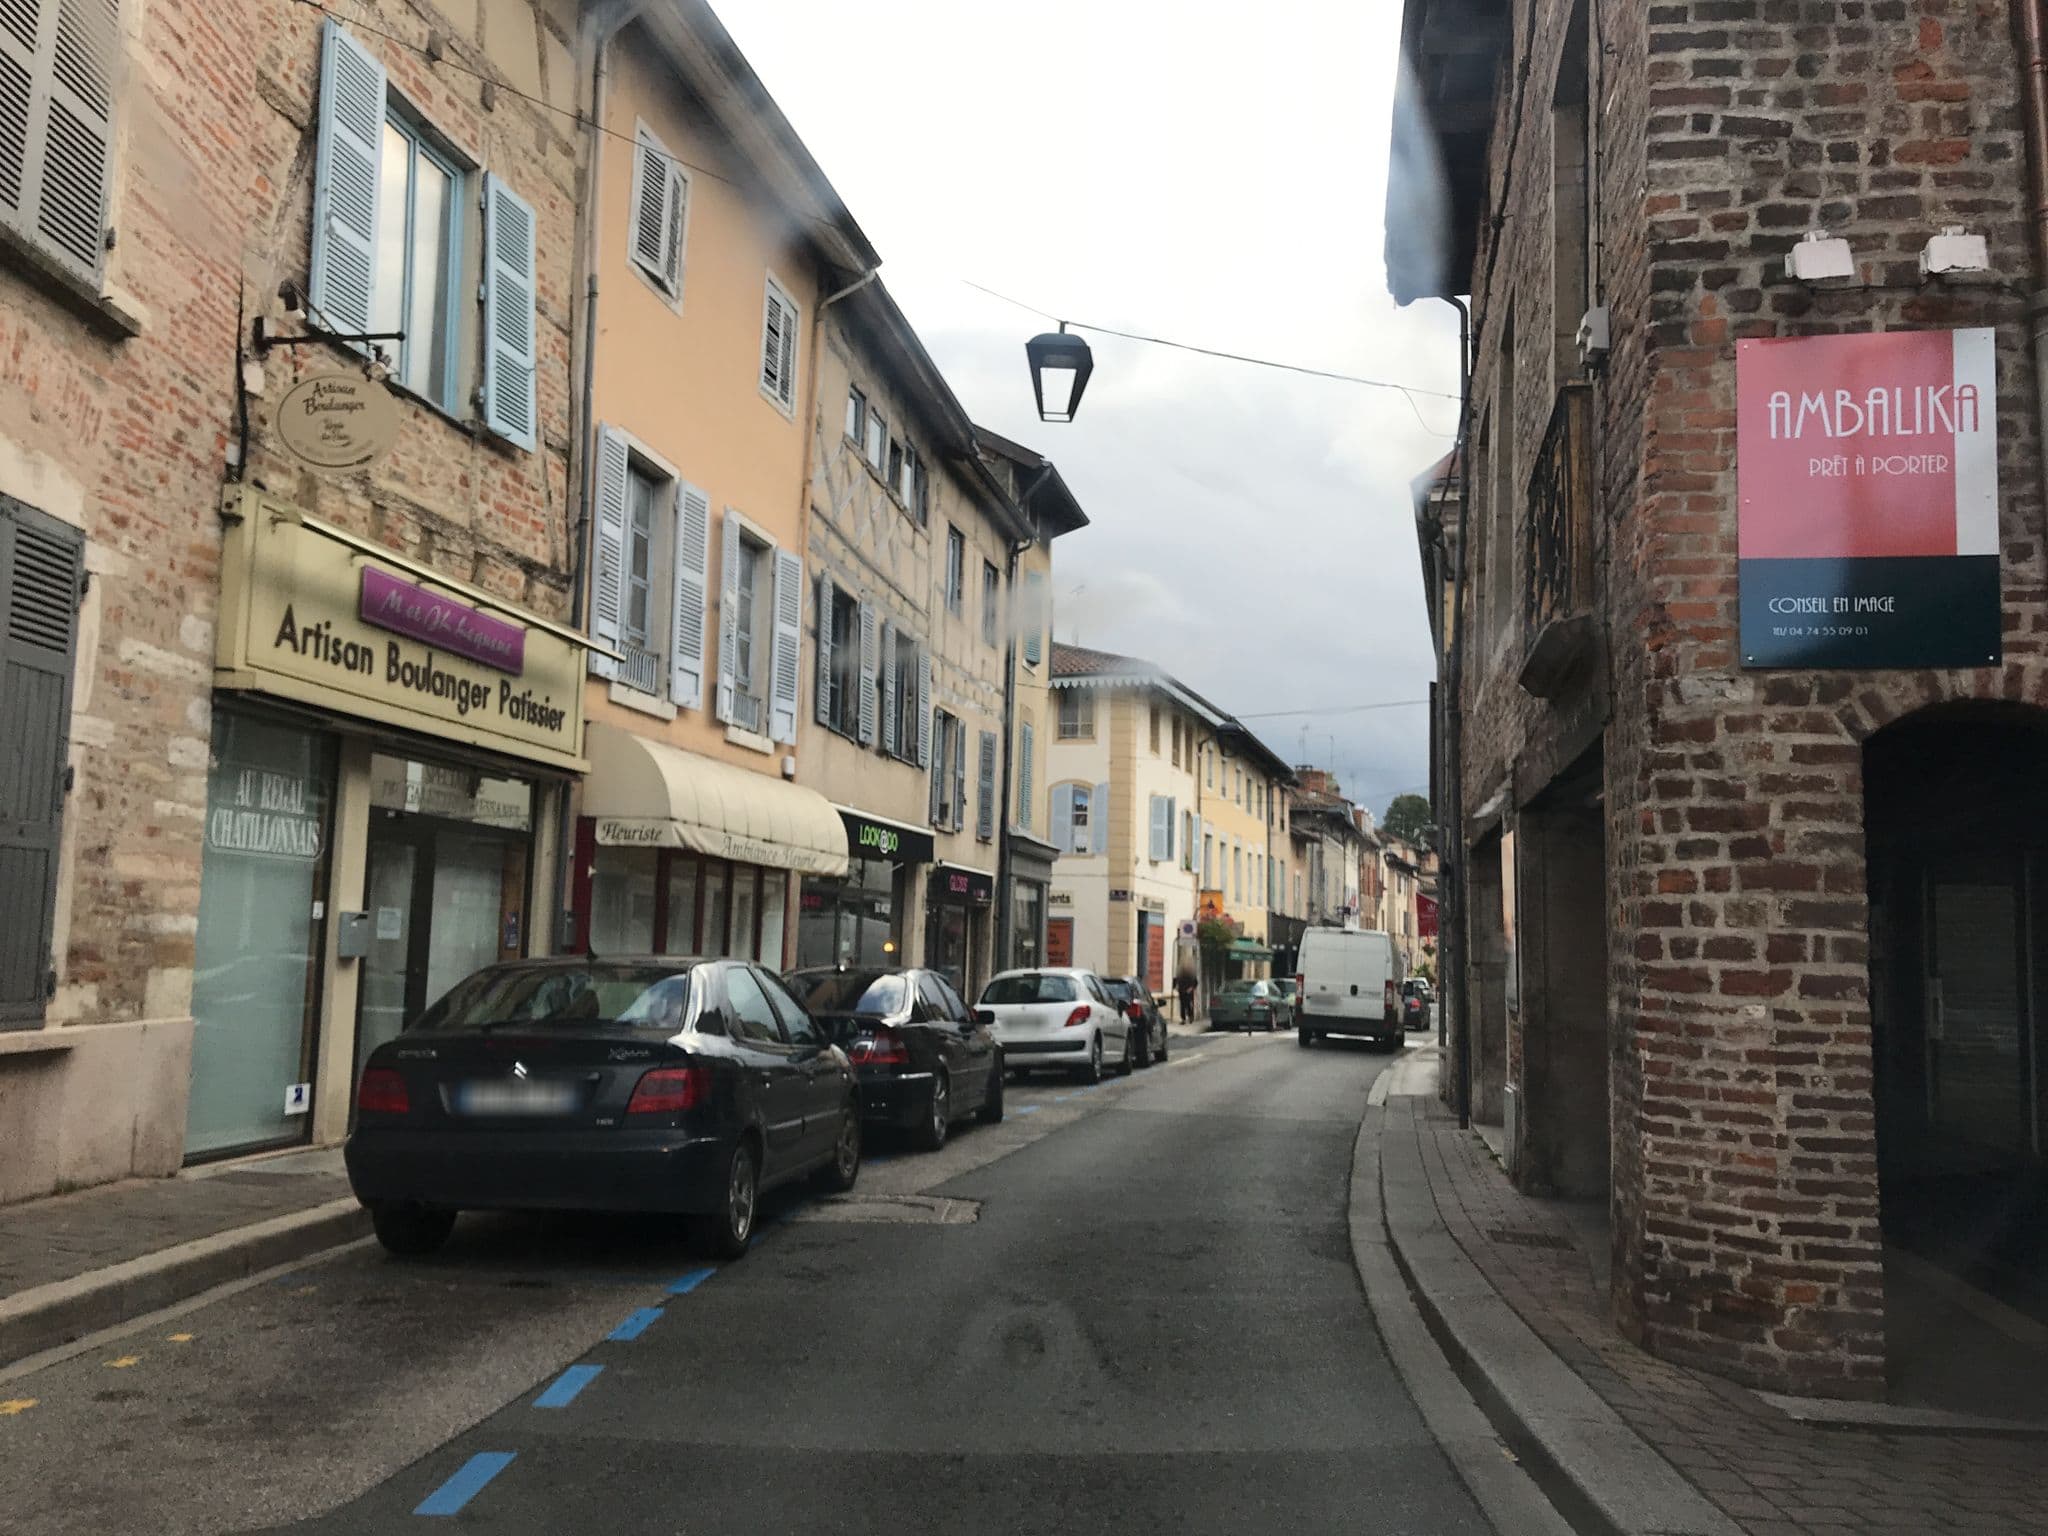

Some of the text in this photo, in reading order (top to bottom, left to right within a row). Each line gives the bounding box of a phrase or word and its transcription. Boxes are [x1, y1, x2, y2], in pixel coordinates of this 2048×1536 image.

[1767, 384, 1979, 440] AMBALIKA
[1809, 454, 1848, 477] PRÊT
[1872, 455, 1949, 475] PORTER
[1768, 596, 1895, 613] CONSEIL EN IMAGE
[1789, 626, 1803, 636] 04
[274, 603, 566, 732] Artisan Boulanger Patissier
[235, 768, 257, 808] AU
[602, 822, 663, 842] Fleuriste
[722, 835, 778, 864] Ambiance
[1048, 893, 1072, 904] ents
